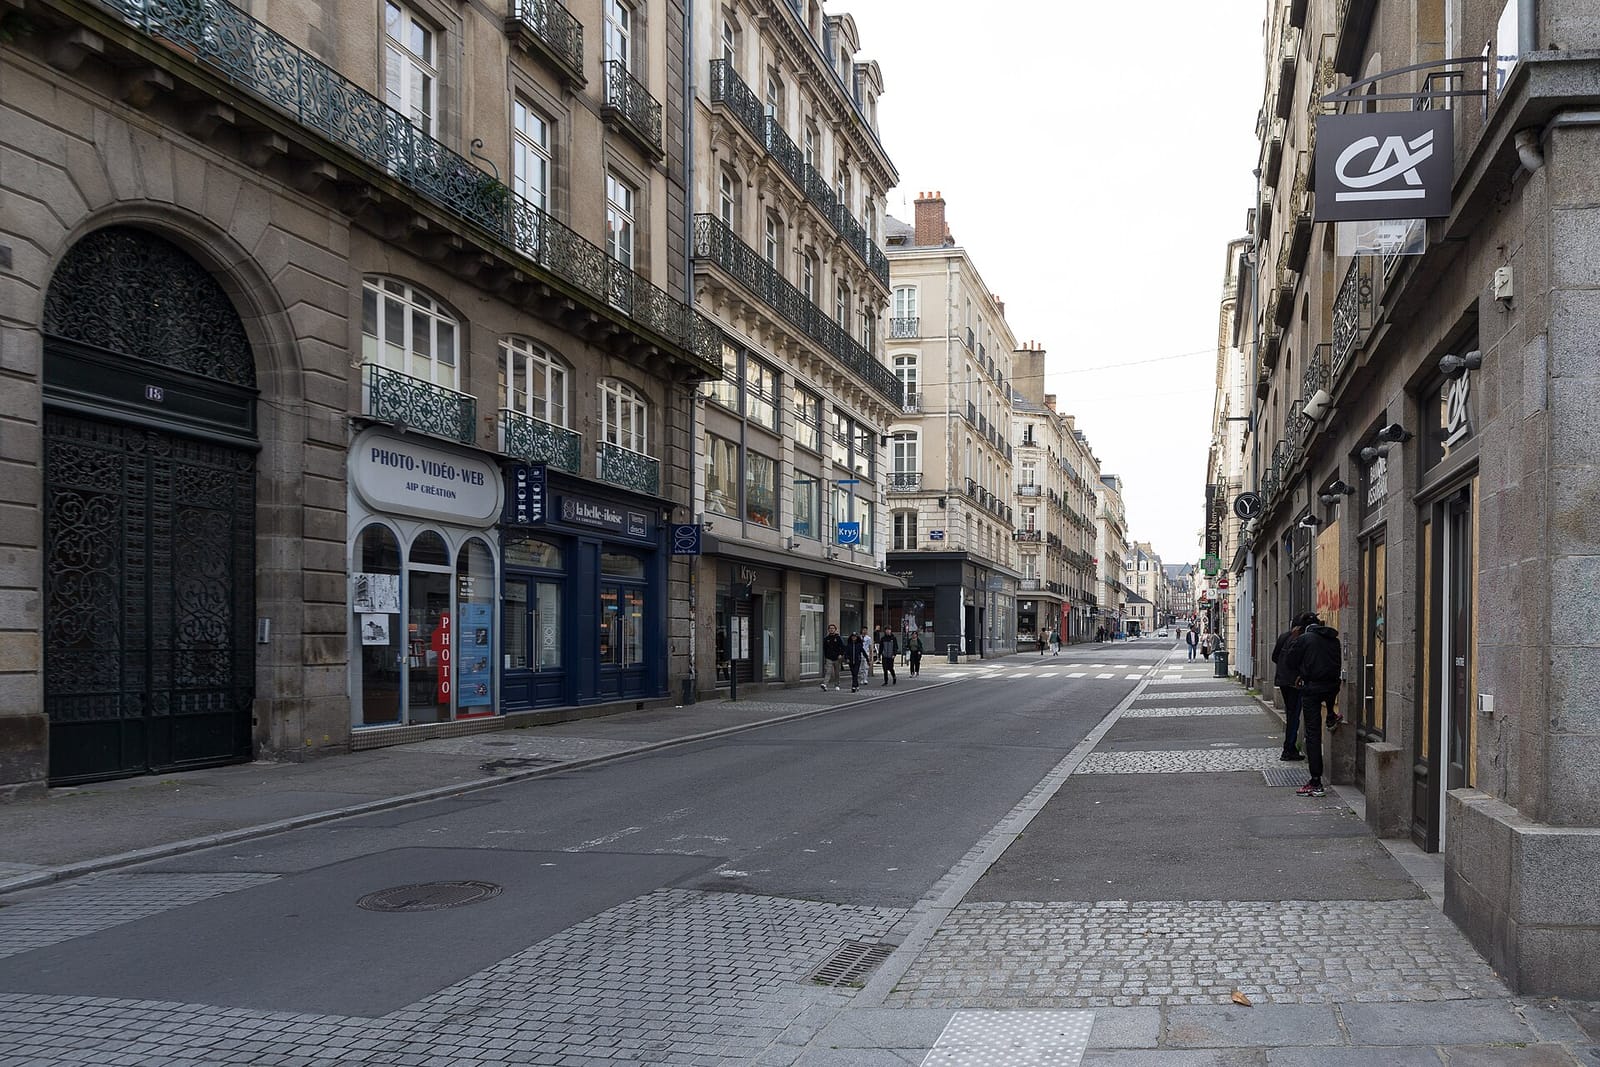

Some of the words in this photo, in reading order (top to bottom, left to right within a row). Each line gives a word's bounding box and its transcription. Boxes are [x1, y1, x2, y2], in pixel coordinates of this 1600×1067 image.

[371, 448, 414, 471] PHOTO
[421, 460, 455, 480] VIDÉO
[461, 468, 485, 486] WEB
[406, 482, 419, 491] AIP
[420, 484, 457, 499] CRÉATION
[838, 527, 857, 537] Krys
[741, 565, 757, 587] Krys
[441, 617, 450, 693] PHOTO
